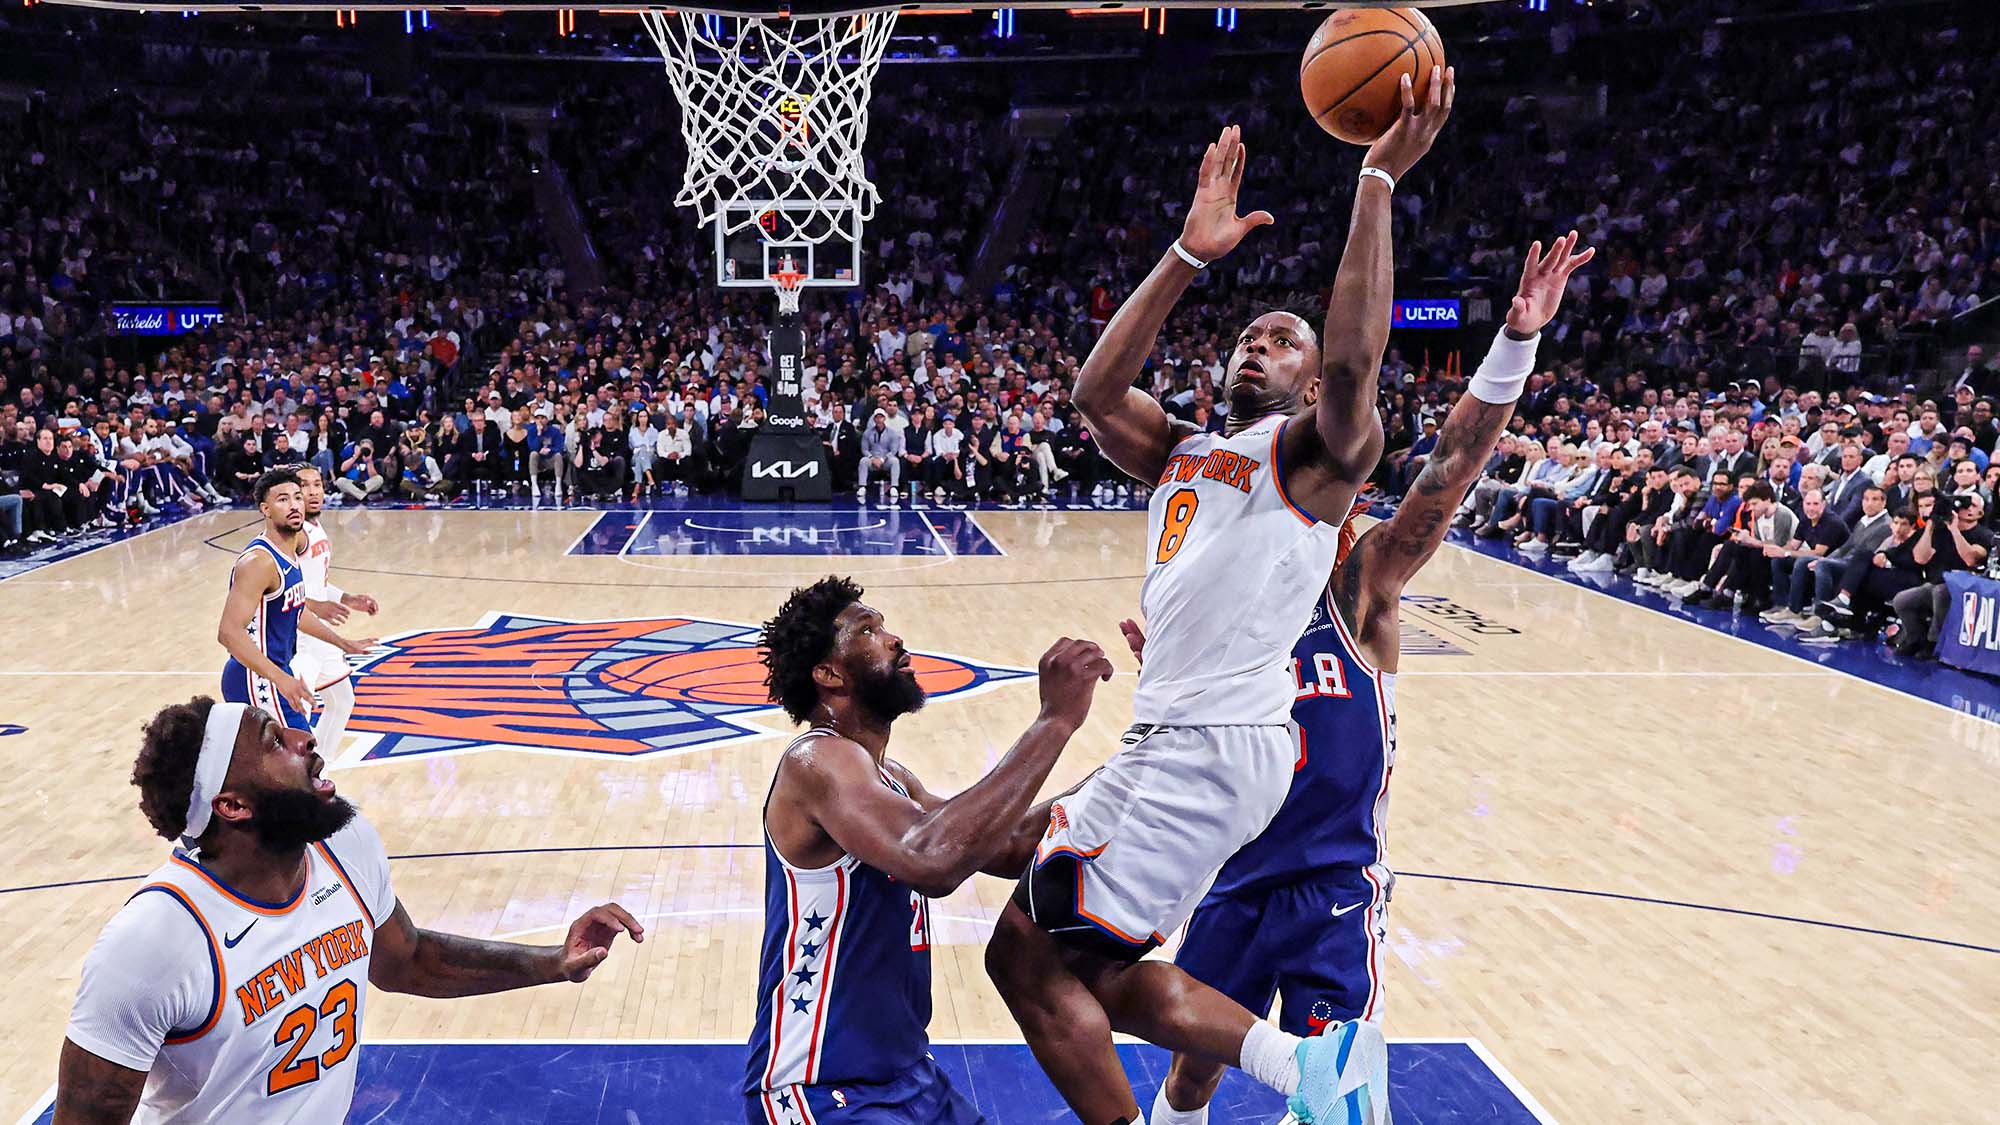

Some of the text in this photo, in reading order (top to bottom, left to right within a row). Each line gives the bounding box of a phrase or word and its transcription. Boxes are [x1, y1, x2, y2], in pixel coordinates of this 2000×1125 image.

[1406, 307, 1458, 321] ULTRA
[780, 355, 795, 368] GET
[780, 368, 796, 381] THE
[769, 414, 804, 428] Google
[752, 460, 818, 478] KIA
[1158, 448, 1260, 495] EW ORK
[1155, 488, 1200, 565] 8
[1971, 595, 2000, 651] PL
[236, 919, 369, 1027] NEW YORK
[266, 977, 359, 1097] 23
